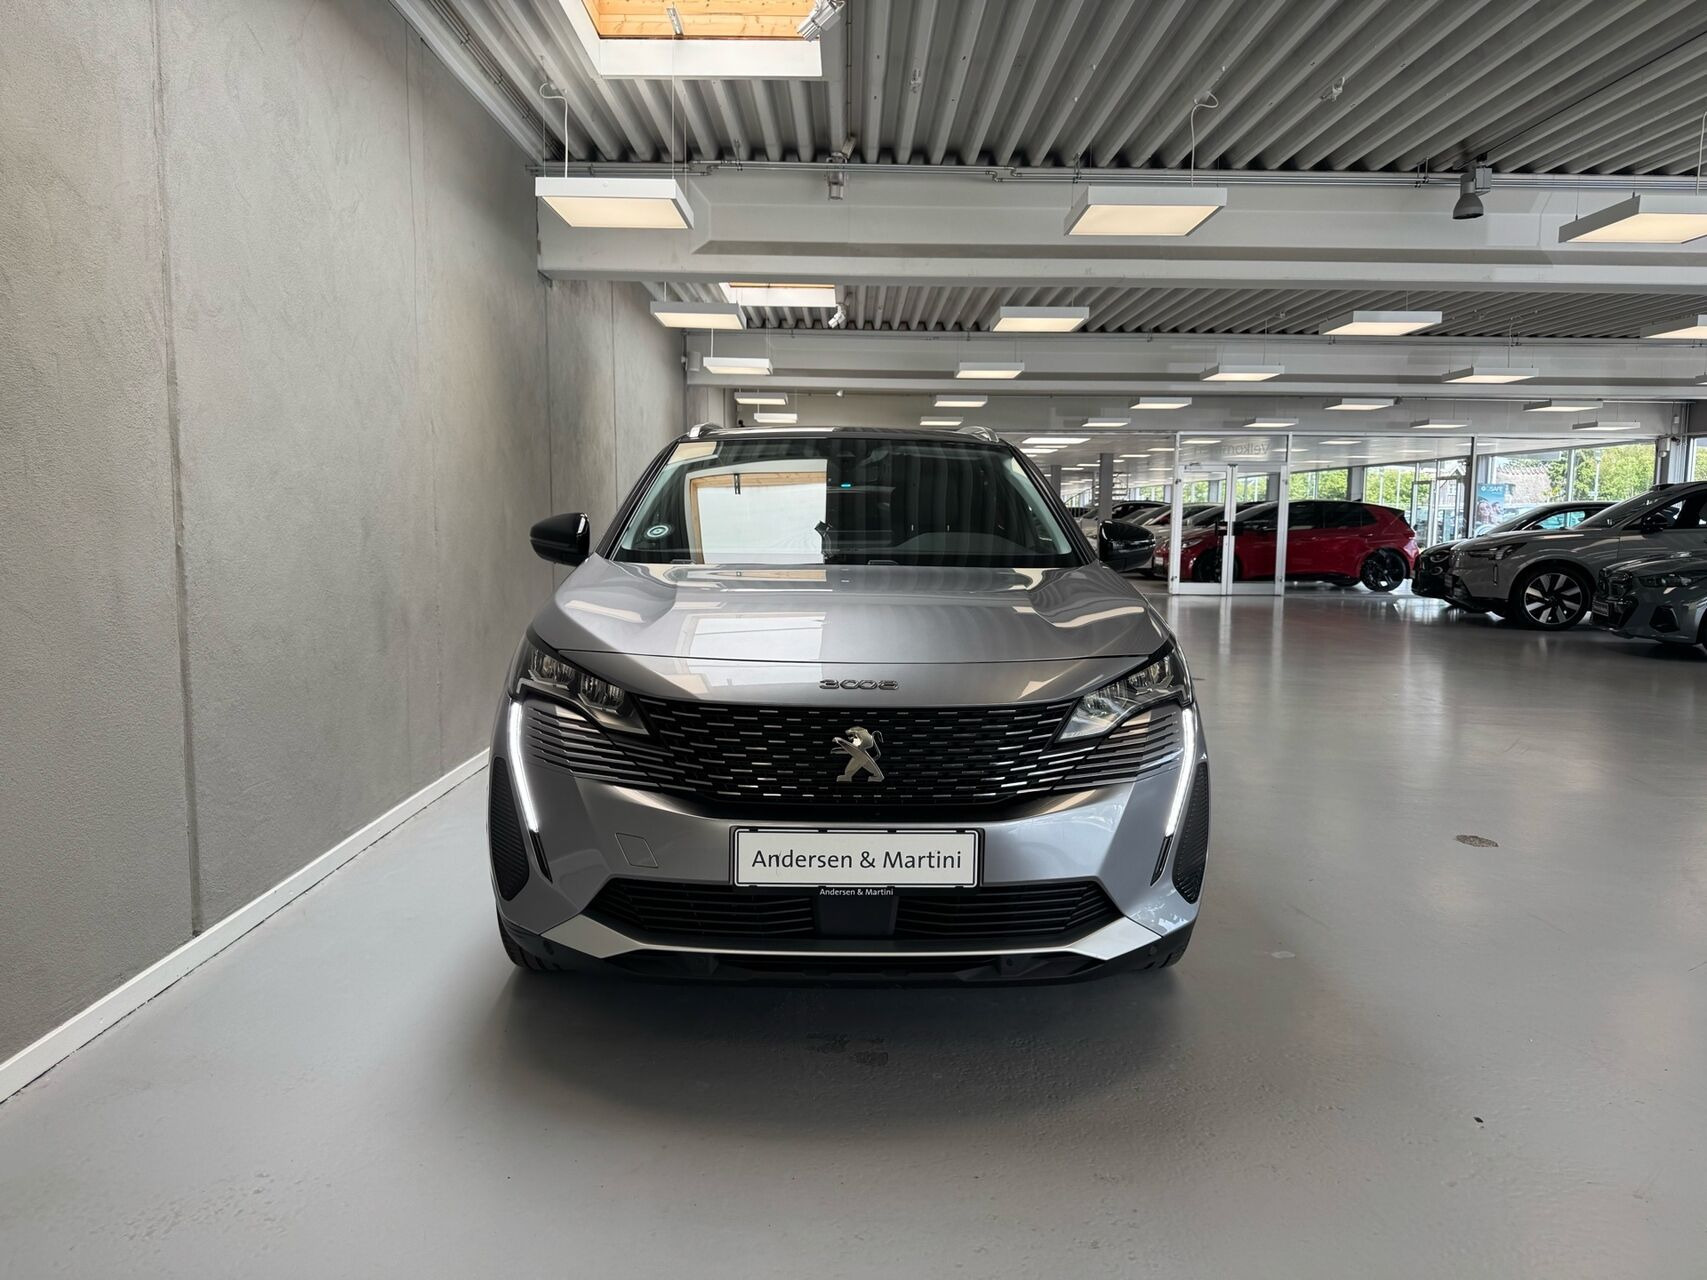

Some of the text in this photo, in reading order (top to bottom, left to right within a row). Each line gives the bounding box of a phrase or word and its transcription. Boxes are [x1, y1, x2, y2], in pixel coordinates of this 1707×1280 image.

[819, 679, 899, 690] 3008
[751, 849, 962, 869] Andersen & Martini
[819, 888, 894, 896] Andersen & Martini
